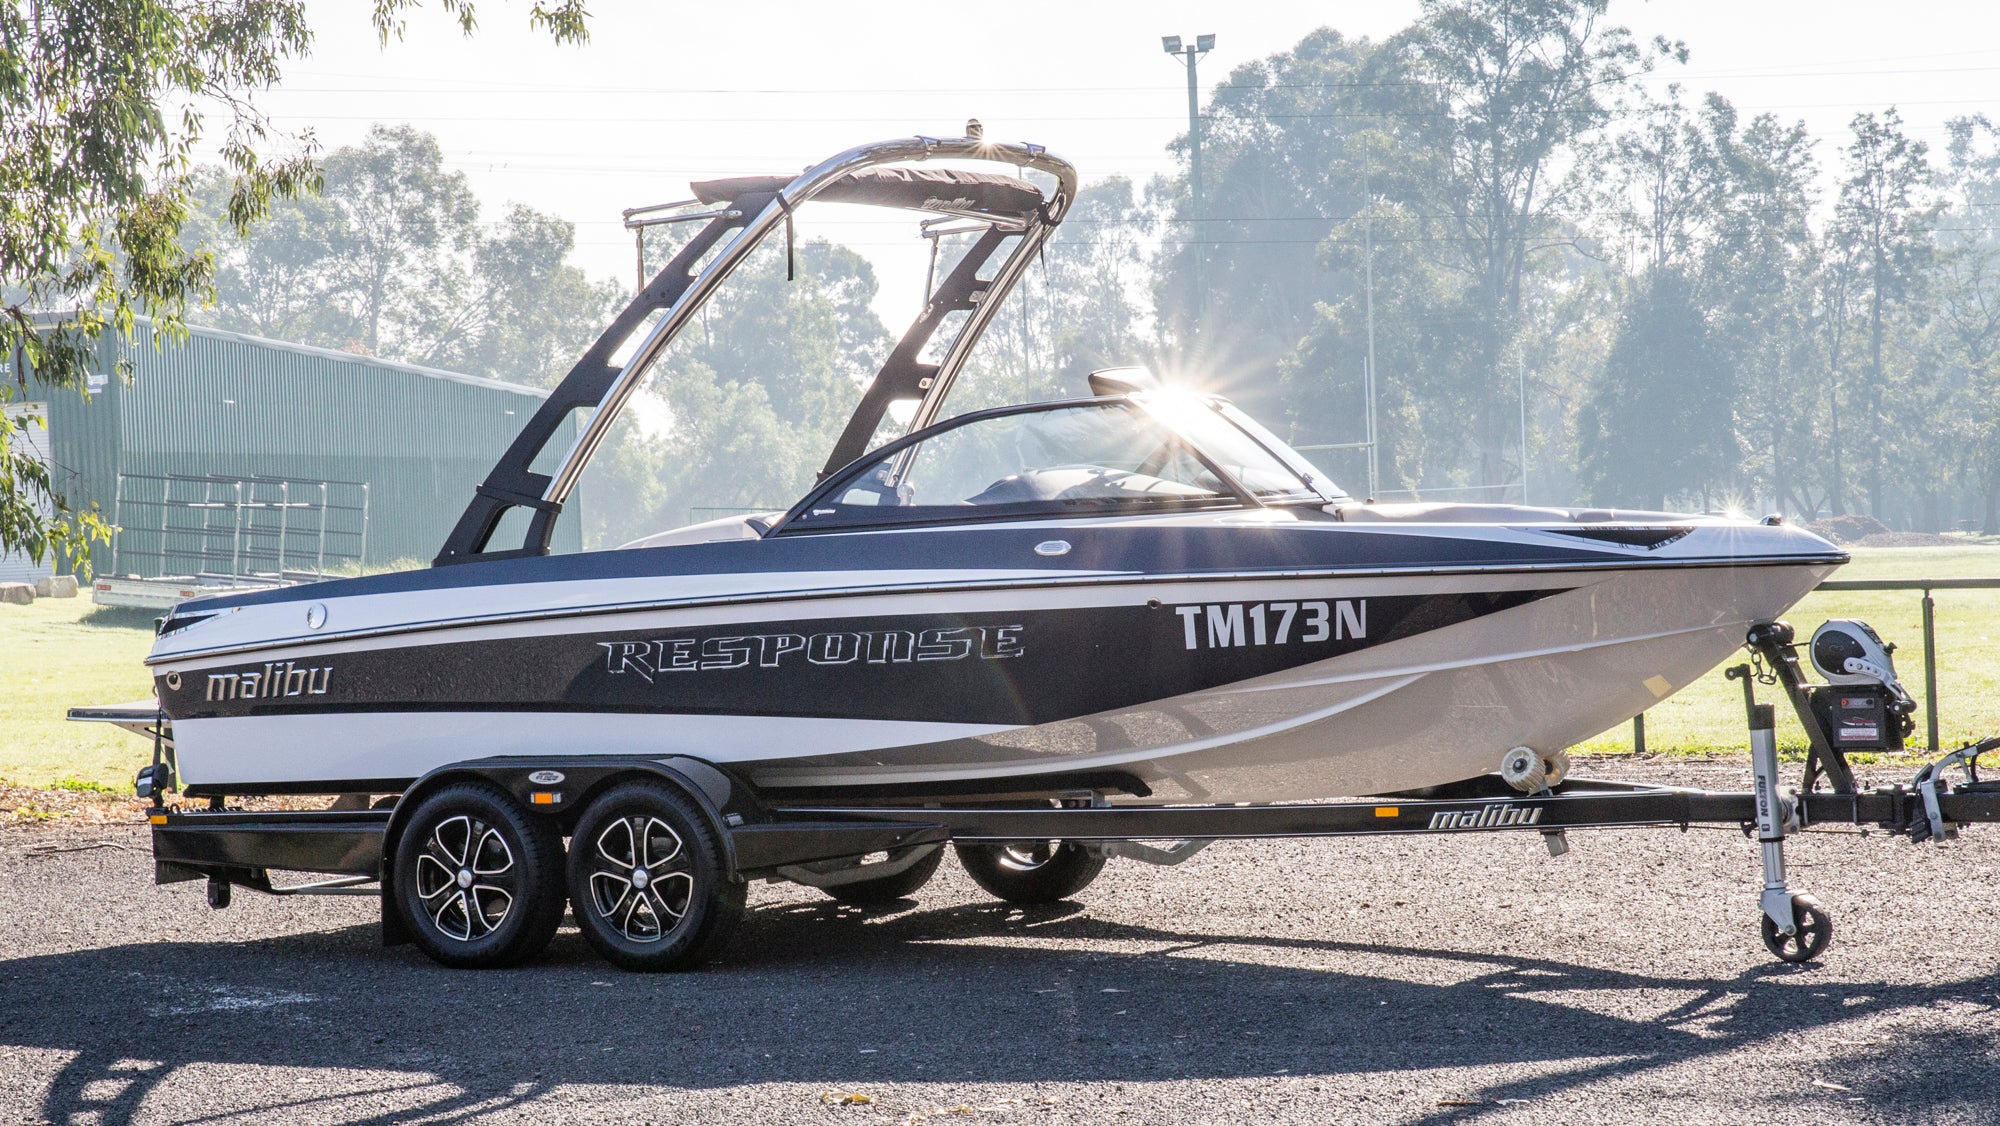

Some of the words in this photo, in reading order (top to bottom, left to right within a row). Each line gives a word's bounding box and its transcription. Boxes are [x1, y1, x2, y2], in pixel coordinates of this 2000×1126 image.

[1175, 599, 1367, 650] TM173N
[597, 625, 1026, 684] RESPONSE
[206, 661, 333, 701] malibu
[1428, 803, 1543, 829] malibu
[1758, 775, 1769, 817] FULTON
